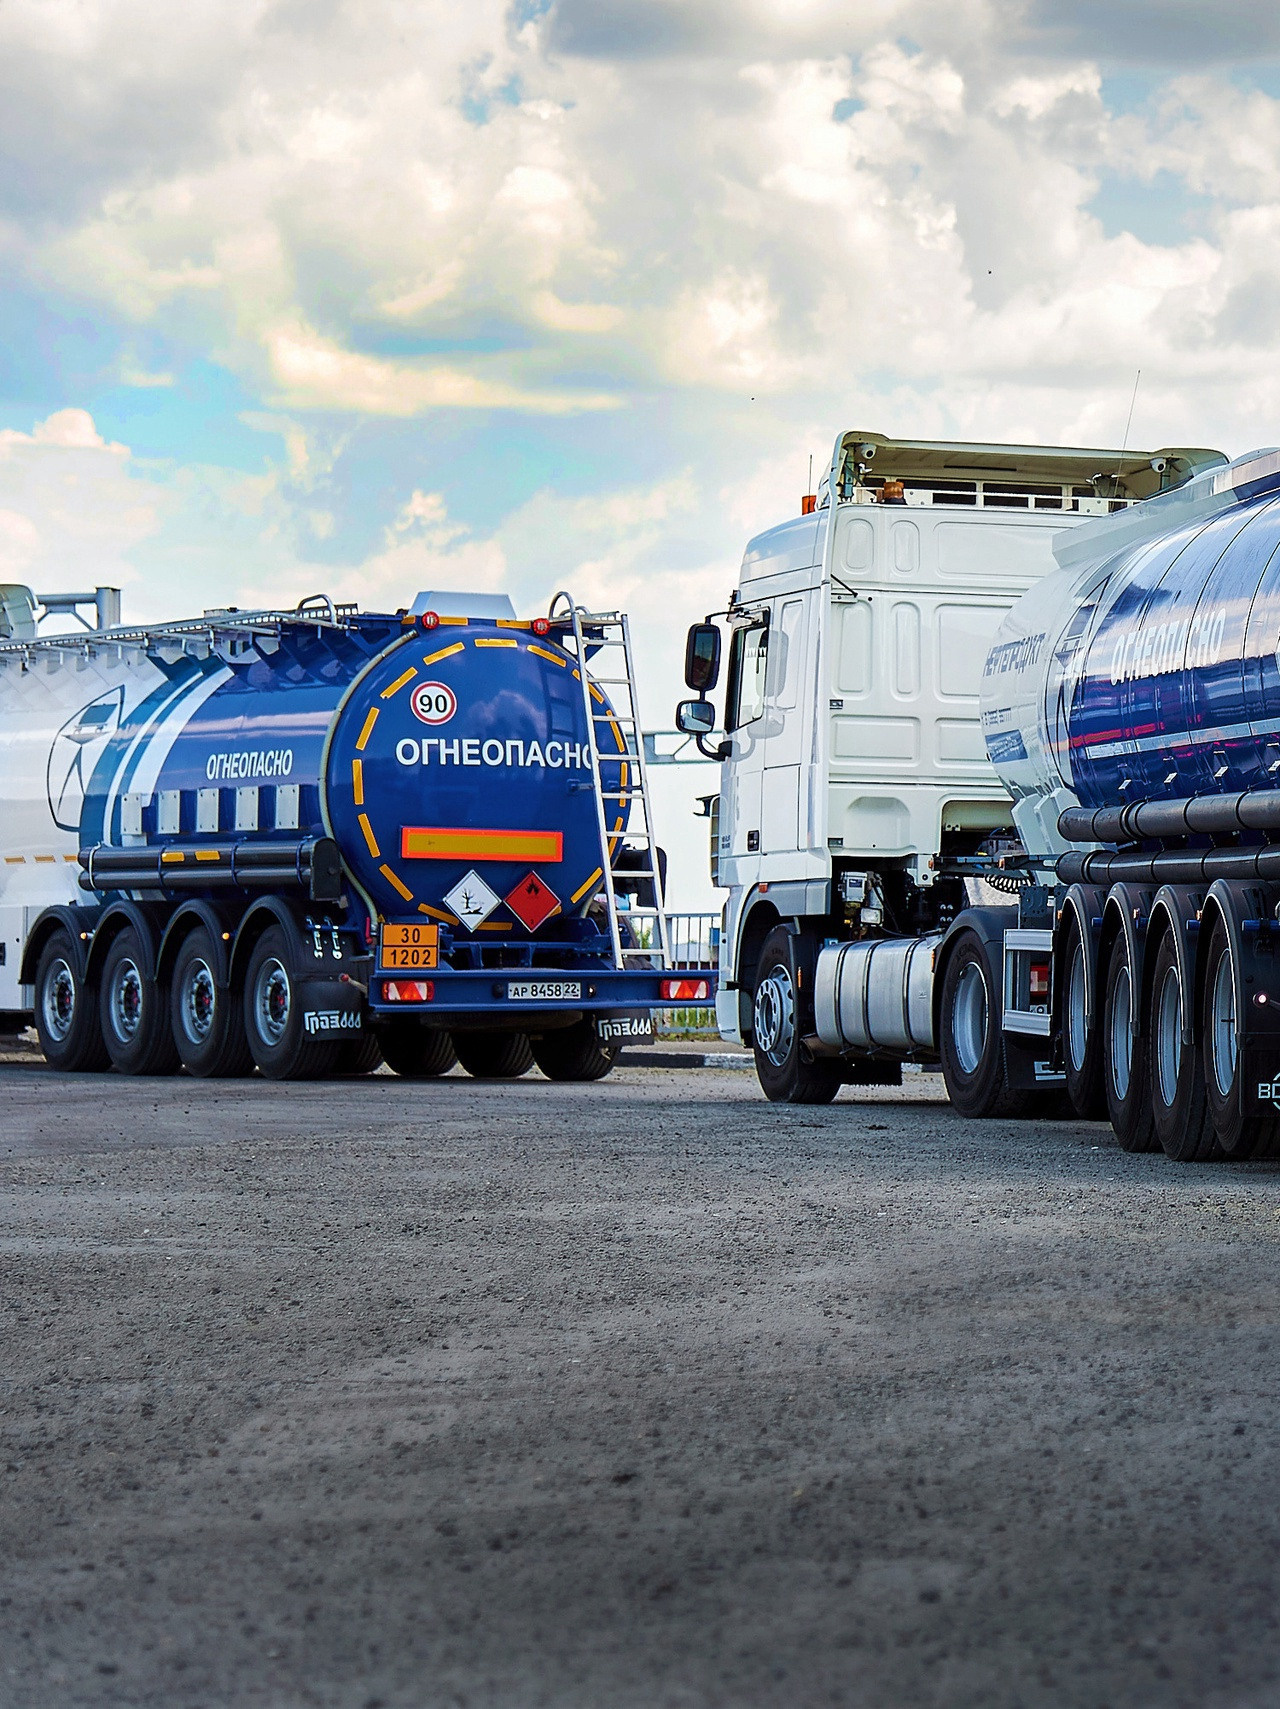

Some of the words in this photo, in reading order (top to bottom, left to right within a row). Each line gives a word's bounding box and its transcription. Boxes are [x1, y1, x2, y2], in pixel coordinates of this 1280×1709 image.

[1110, 607, 1226, 686] ОГНЕОПАСНО
[419, 694, 448, 714] 90
[206, 748, 293, 780] ОГНЕОПАСНО
[401, 927, 421, 944] 30
[390, 949, 432, 966] 1202
[531, 984, 562, 997] 8458
[564, 983, 577, 994] 22
